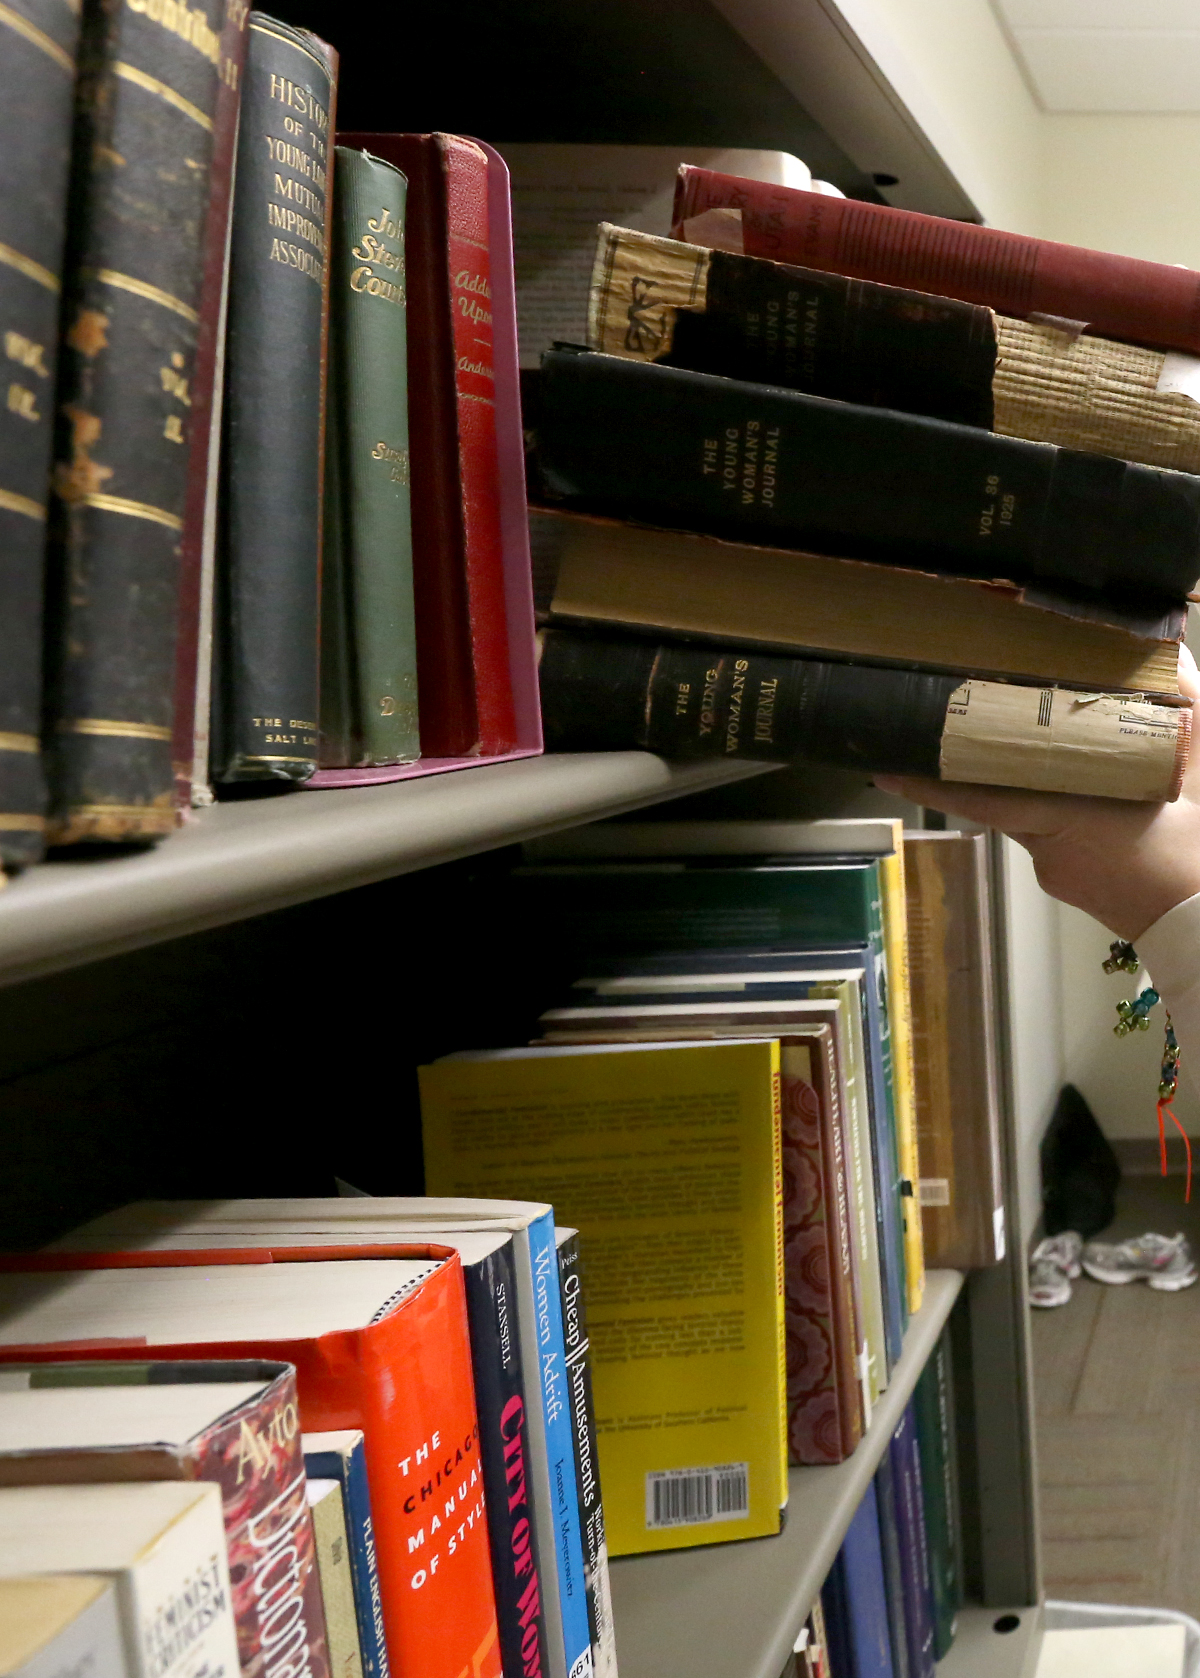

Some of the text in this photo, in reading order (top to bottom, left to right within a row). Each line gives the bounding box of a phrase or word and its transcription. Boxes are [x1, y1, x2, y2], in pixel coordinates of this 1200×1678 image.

[266, 134, 310, 177] YOUNG
[283, 116, 304, 137] OF
[703, 438, 718, 475] THE
[722, 427, 739, 490] YOUNG
[741, 420, 760, 505] WOMAN'S
[761, 427, 780, 509] JOURNAL
[1000, 494, 1015, 527] 1925
[252, 718, 283, 728] THE
[676, 682, 691, 716] THE
[699, 667, 719, 738] YOUNG
[726, 659, 750, 753] WOMAN'S
[754, 677, 779, 744] JOURNAL
[265, 733, 297, 744] SALT
[1119, 727, 1148, 737] PLEASE
[561, 1252, 578, 1270] Peiss
[496, 1283, 512, 1370] STANSELL
[535, 1246, 563, 1427] Women Adrift
[564, 1274, 595, 1508] Cheap Amusements
[236, 1402, 298, 1485] Ayto
[398, 1430, 442, 1477] THE
[403, 1423, 479, 1515] CHICAGO
[407, 1458, 483, 1555] MANUAL
[554, 1457, 566, 1506] Joanne
[363, 1516, 377, 1575] PLAIN
[410, 1491, 486, 1591] OF STYLE
[368, 1573, 385, 1648] ENGLISH
